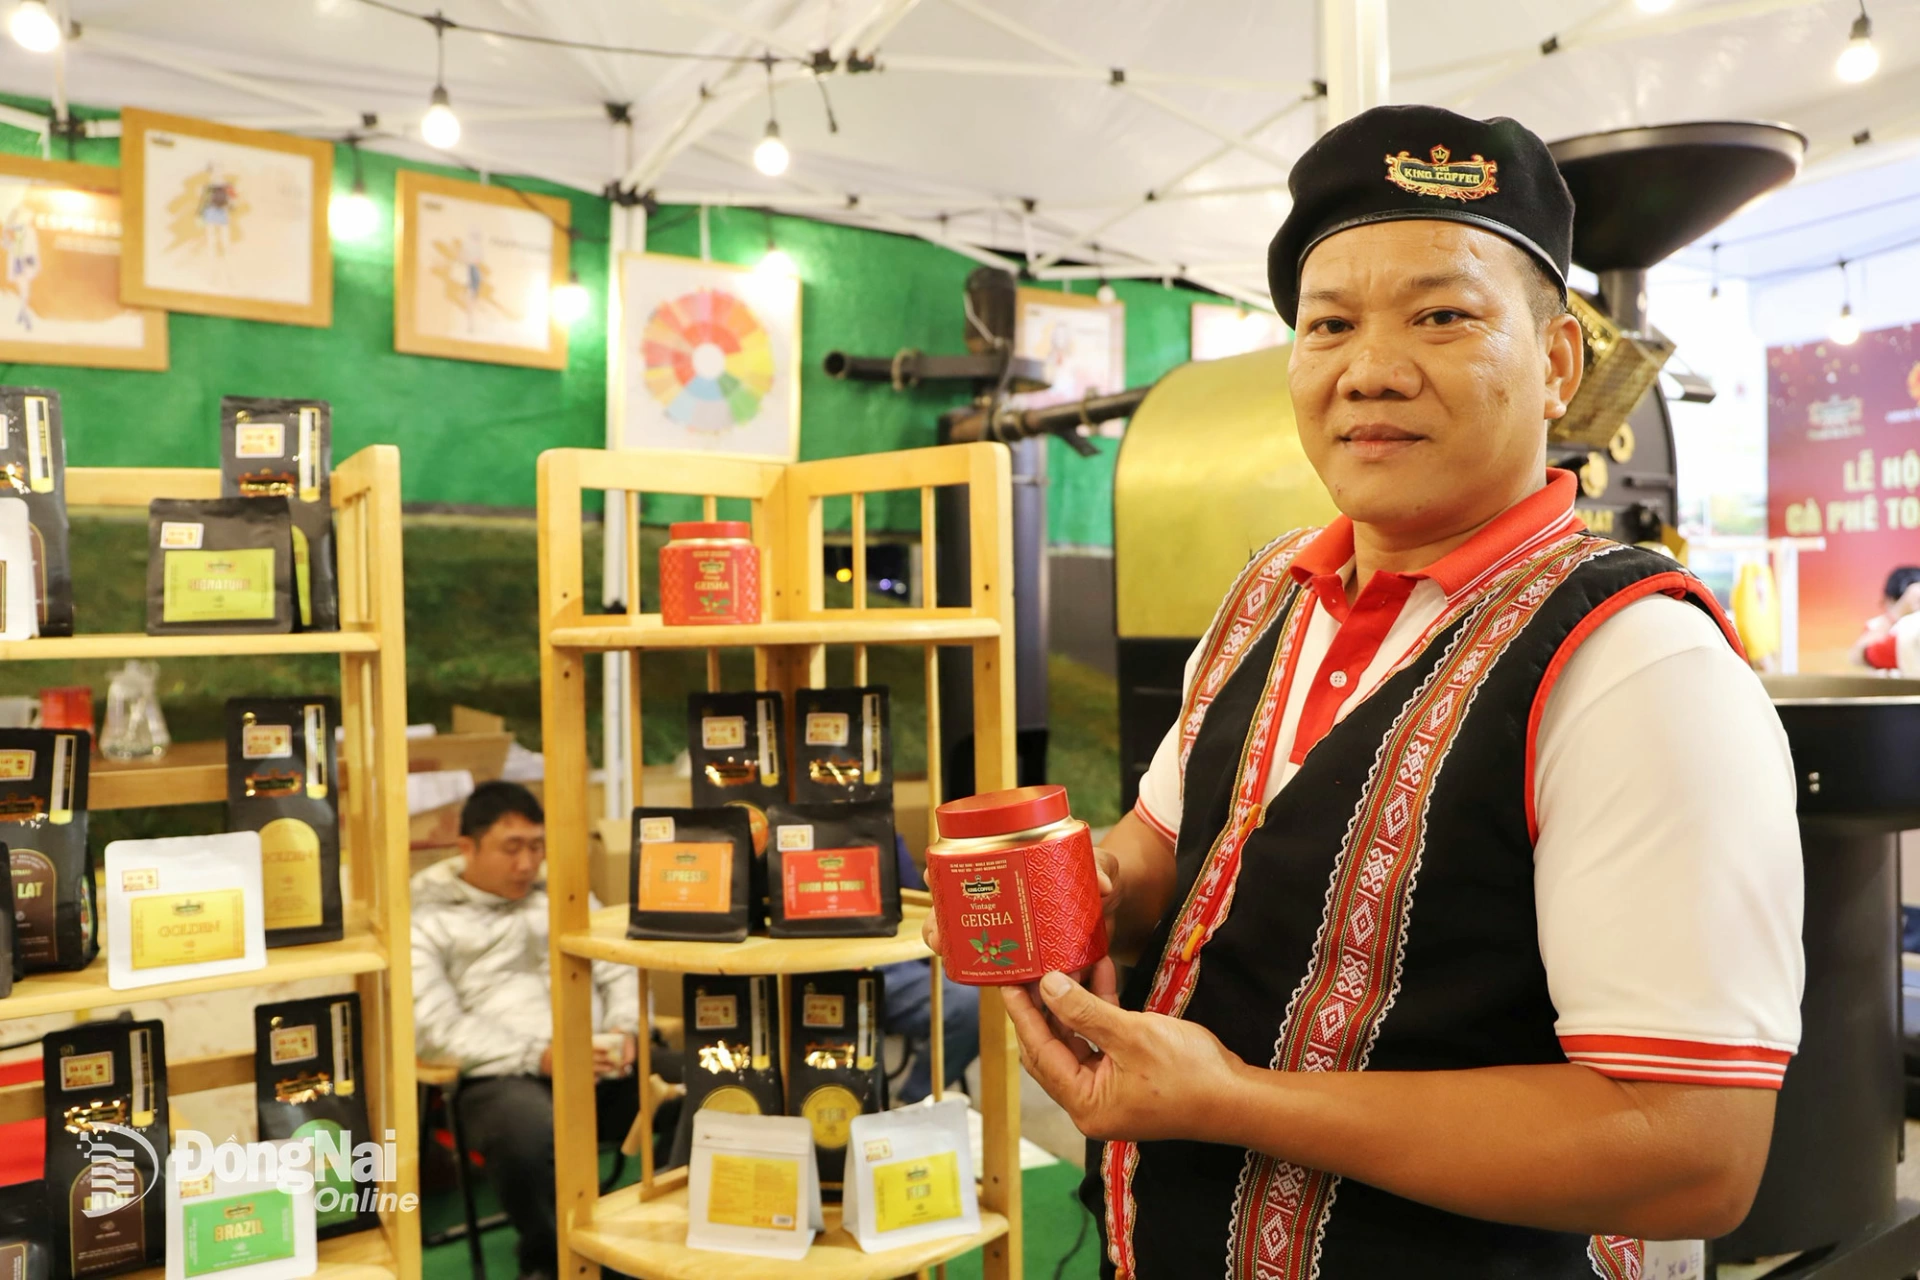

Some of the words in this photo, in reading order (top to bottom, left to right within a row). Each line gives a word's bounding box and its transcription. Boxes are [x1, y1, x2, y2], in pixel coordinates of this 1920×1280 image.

[1404, 168, 1432, 180] KING
[1435, 171, 1480, 184] COFFEE
[17, 882, 44, 899] LAT
[970, 903, 996, 911] Vintage
[960, 911, 1014, 928] GEISHA
[214, 1218, 265, 1243] BRAZIL
